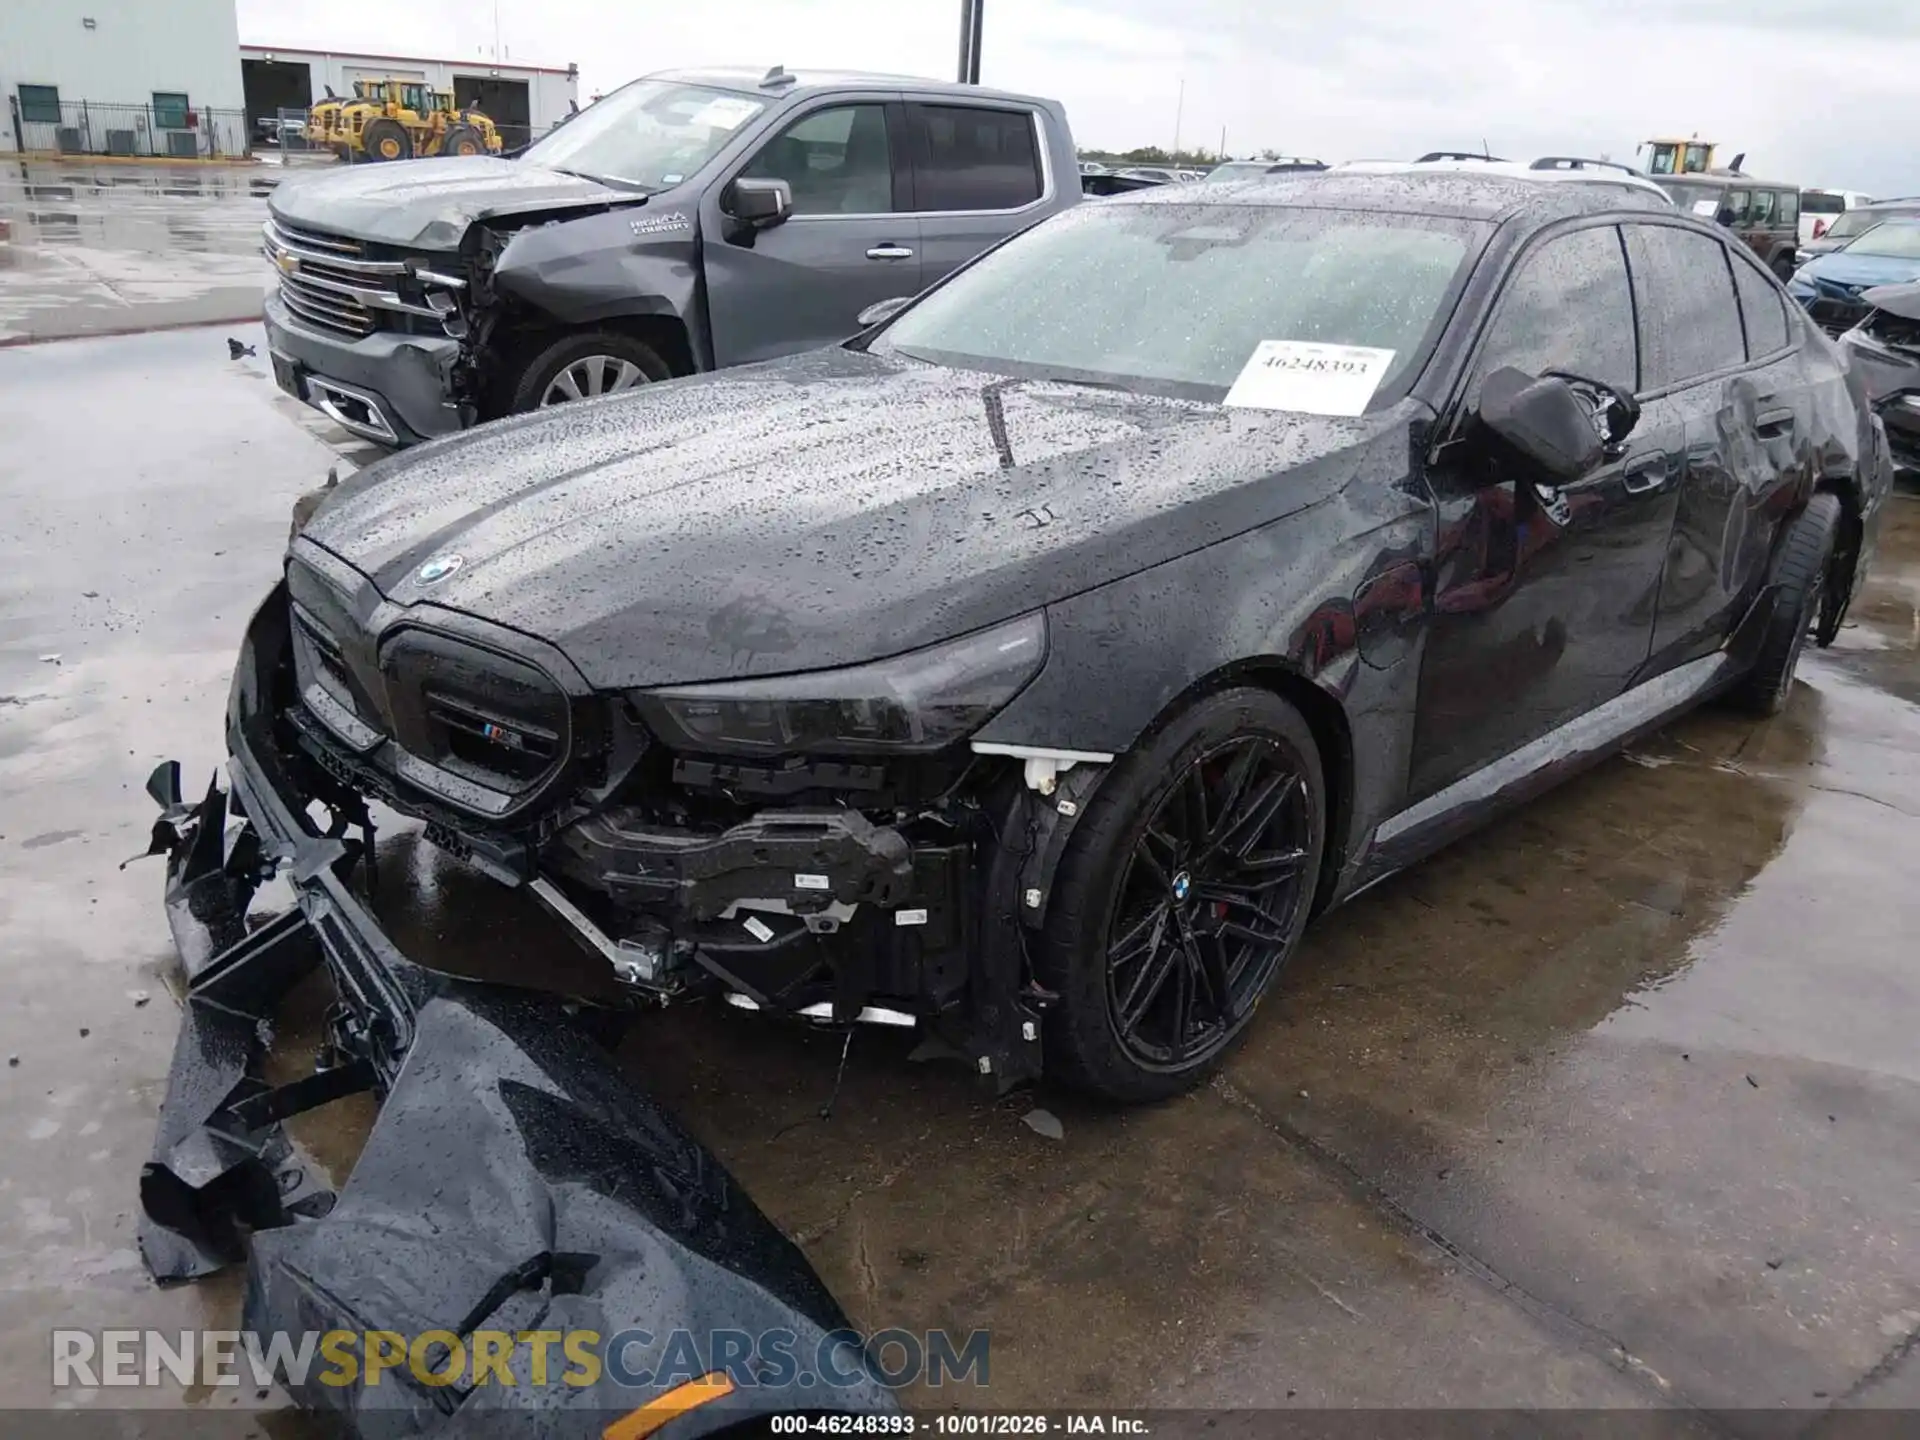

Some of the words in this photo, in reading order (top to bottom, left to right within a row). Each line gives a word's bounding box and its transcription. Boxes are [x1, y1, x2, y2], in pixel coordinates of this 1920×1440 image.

[630, 217, 661, 229] HIGH
[633, 222, 689, 235] COUNTRY
[1262, 355, 1368, 374] 46248393
